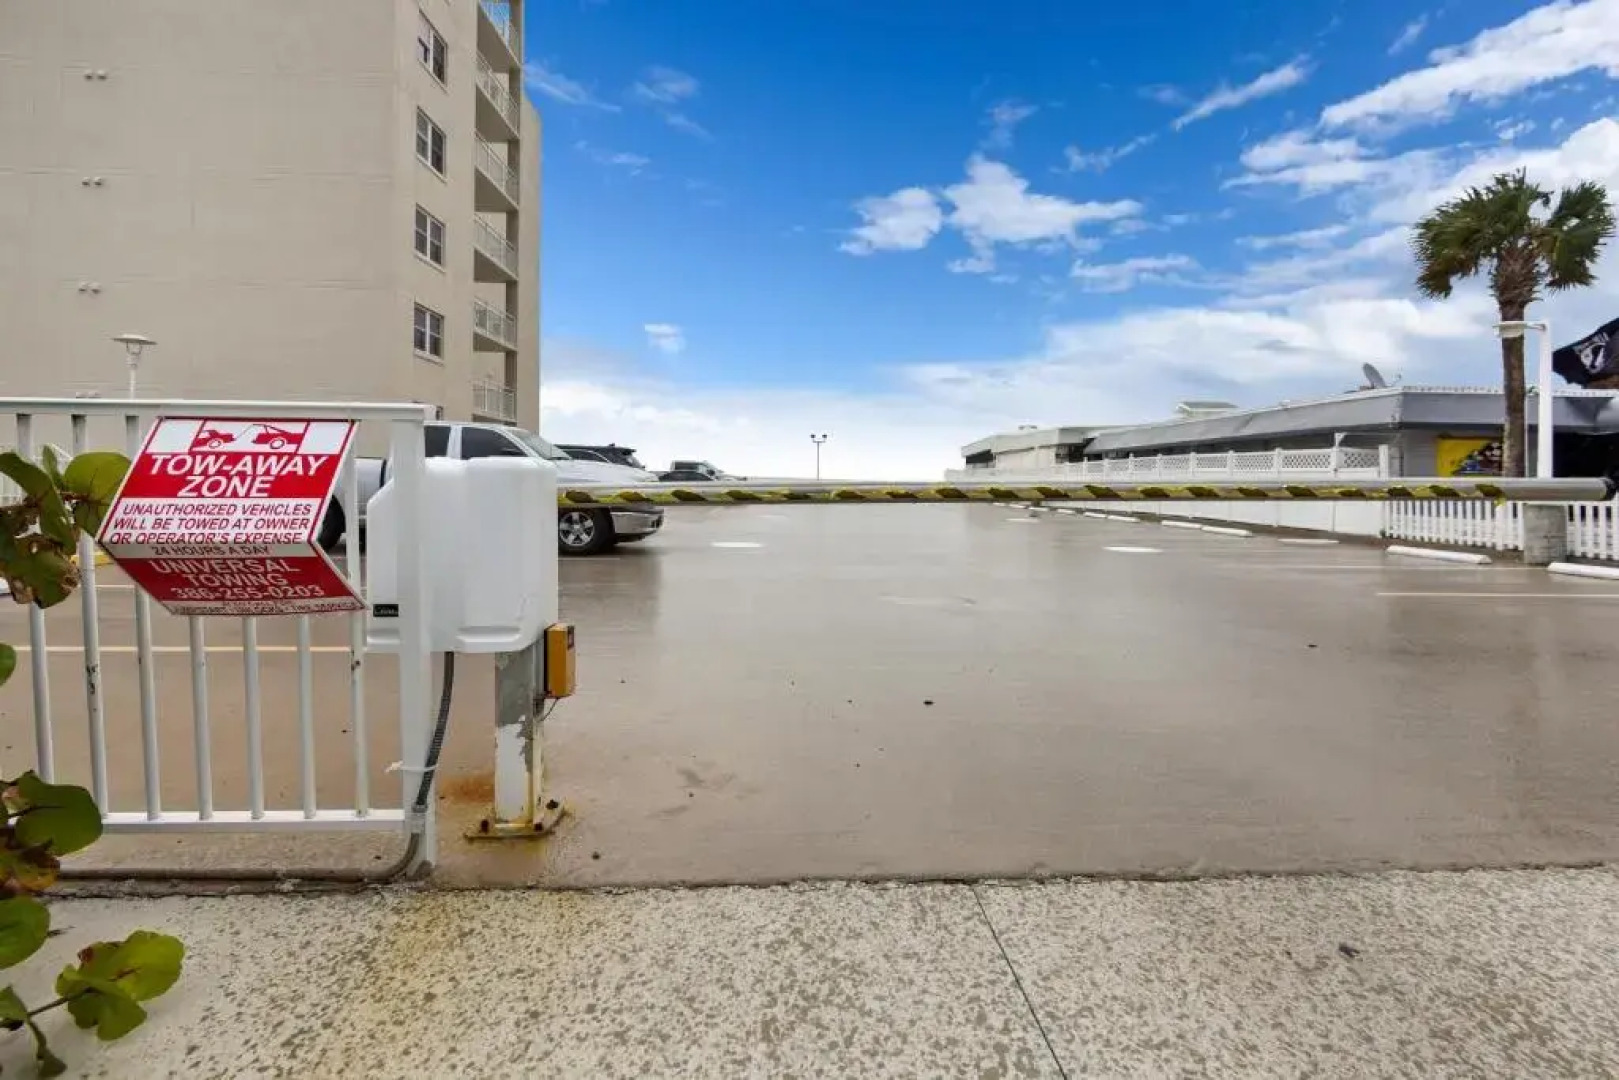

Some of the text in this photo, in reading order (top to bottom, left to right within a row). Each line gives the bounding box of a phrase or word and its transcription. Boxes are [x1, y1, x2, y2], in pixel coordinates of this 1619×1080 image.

[151, 455, 327, 475] TOW-AWAY
[177, 476, 274, 497] ZONE
[123, 504, 312, 515] UNAUTHORIZED VEHICLES
[113, 518, 310, 530] WILL BE TOWED AT OWNER
[110, 533, 303, 544] OR OPERATOR'S EXPENSE
[170, 546, 226, 556] HOURS
[228, 546, 240, 555] A
[149, 558, 301, 573] UNIVERSAL
[181, 573, 288, 587] TOWING
[170, 585, 325, 600] 386-255-0203
